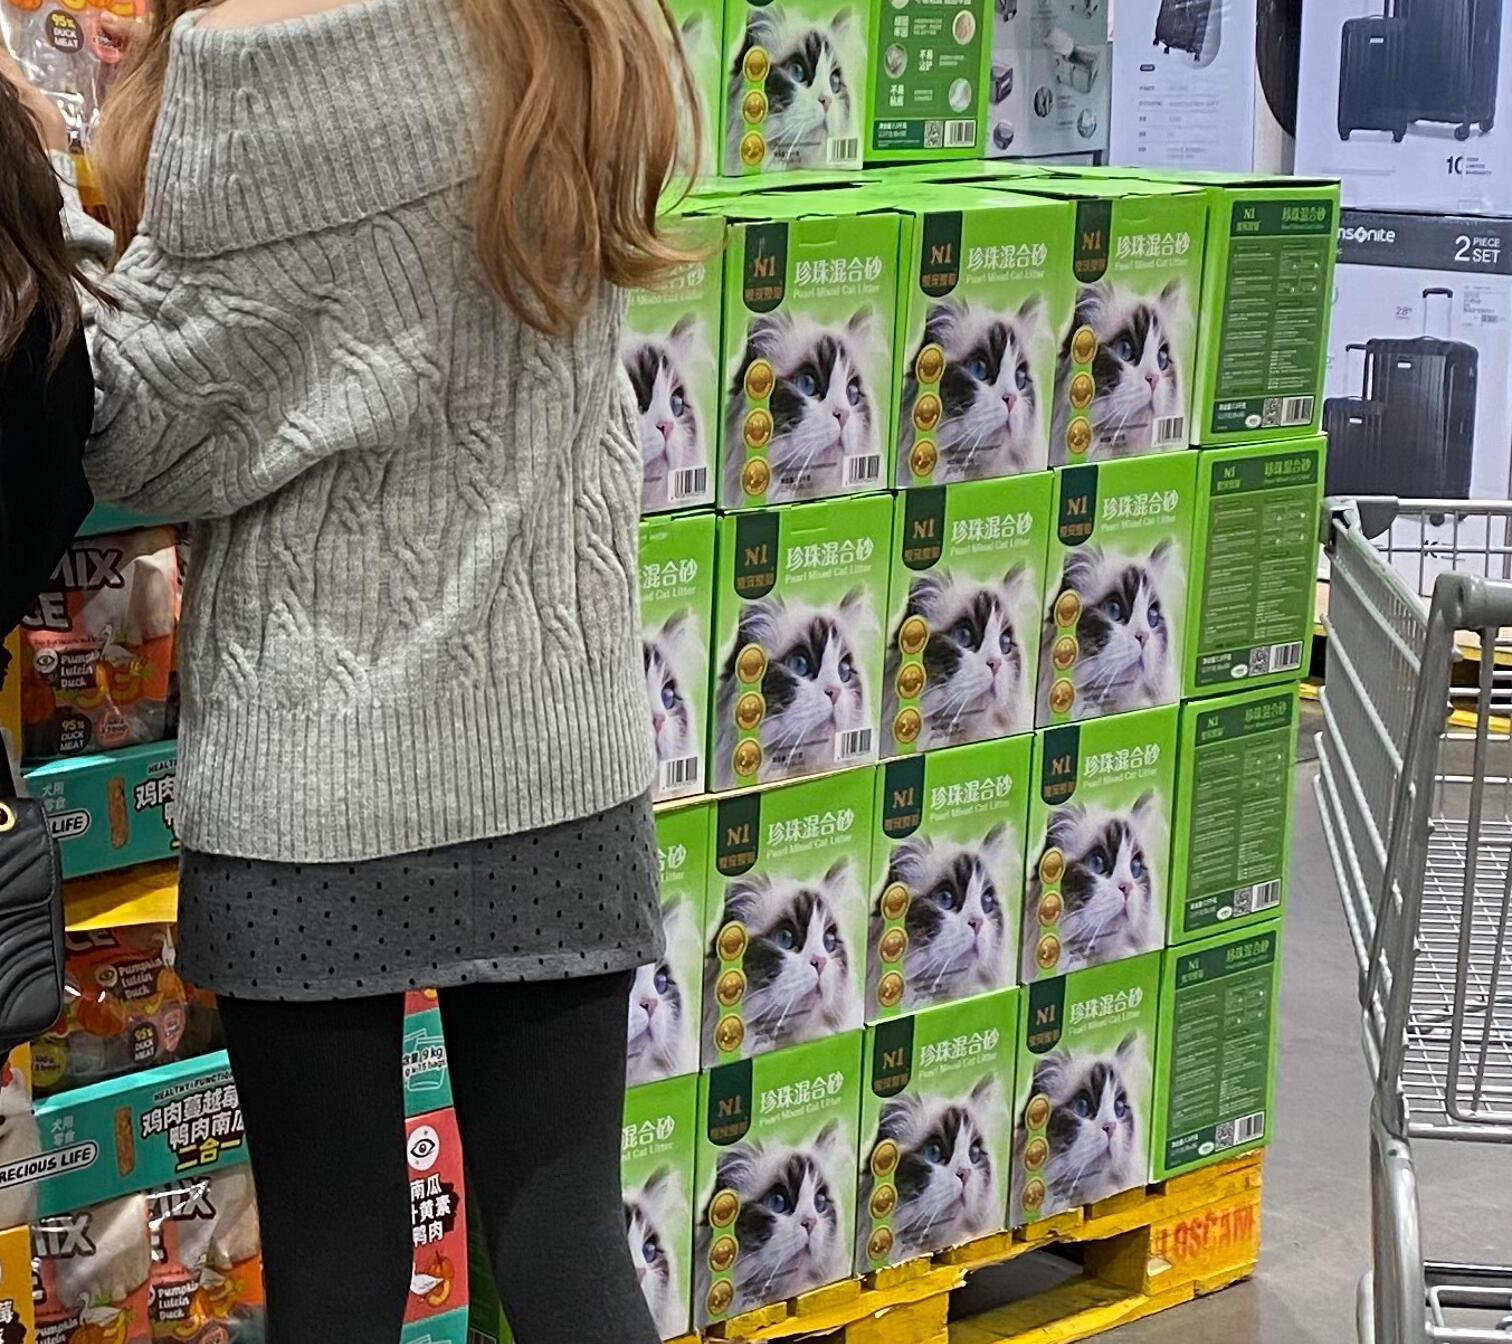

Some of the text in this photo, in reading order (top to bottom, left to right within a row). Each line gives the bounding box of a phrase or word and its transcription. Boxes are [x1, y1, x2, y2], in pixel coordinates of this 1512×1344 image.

[54, 26, 77, 40] DUCK
[54, 36, 80, 50] MEAT
[1082, 231, 1102, 252] N1
[1115, 232, 1191, 258] 珍珠混合砂
[1454, 235, 1470, 263] 2
[1472, 237, 1501, 248] PIECE
[930, 242, 953, 265] N1
[967, 242, 1049, 271] 珍珠混合砂
[1471, 249, 1501, 264] SET
[754, 257, 776, 278] N1
[794, 255, 883, 287] 珍珠混合砂
[1067, 496, 1088, 516] N1
[1102, 488, 1180, 519] 珍珠混合砂
[913, 519, 935, 540] N1
[951, 512, 1034, 544] 珍珠混合砂
[743, 545, 769, 567] N1
[785, 536, 875, 572] 珍珠混合砂
[1051, 756, 1073, 777] N1
[1083, 743, 1161, 777] 珍珠混合砂
[893, 787, 915, 810] N1
[930, 775, 1014, 809] 珍珠混合砂
[726, 822, 750, 847] N1
[766, 808, 856, 848] 珍珠混合砂
[1036, 1006, 1057, 1027] N1
[1069, 987, 1144, 1025] 珍珠混合砂
[919, 1027, 1001, 1068] 珍珠混合砂
[881, 1049, 904, 1071] N1
[759, 1071, 845, 1115] 珍珠混合砂
[718, 1095, 742, 1118] N1
[61, 1146, 91, 1167] LIFE
[177, 1138, 242, 1171] 二合一
